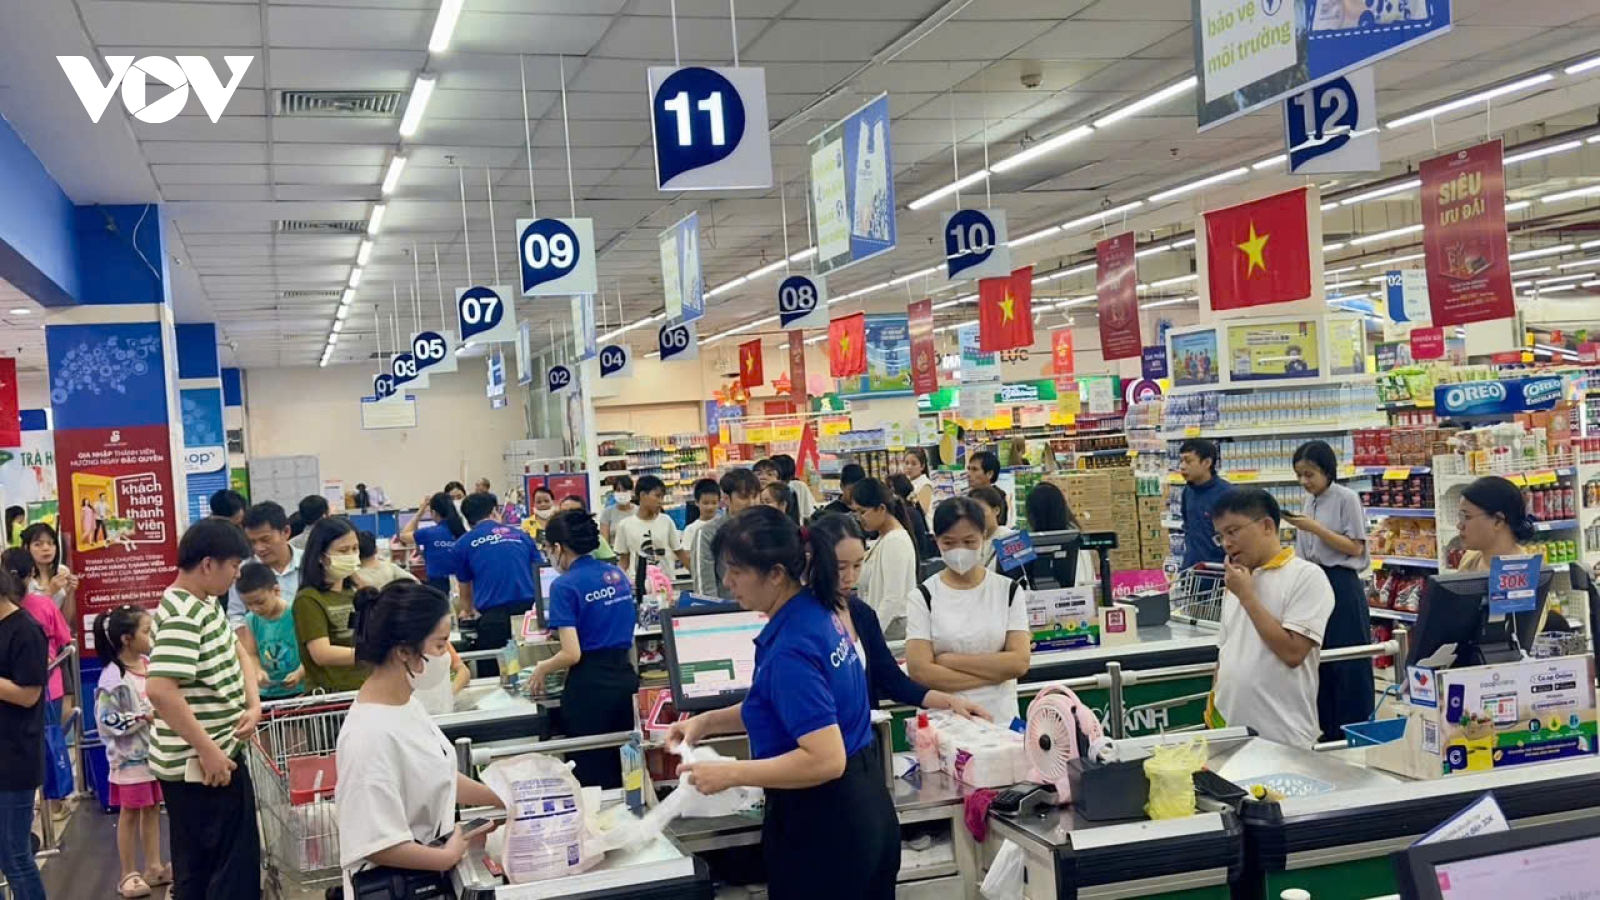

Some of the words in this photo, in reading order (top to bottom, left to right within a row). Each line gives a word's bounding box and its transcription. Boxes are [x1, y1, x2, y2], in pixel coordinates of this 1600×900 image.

[1208, 42, 1235, 75] môi
[1238, 20, 1291, 60] trường
[664, 91, 726, 146] 11
[1294, 87, 1350, 136] 12
[1439, 171, 1482, 205] SIÊU
[950, 222, 989, 255] 10
[524, 232, 575, 269] 09
[781, 285, 815, 310] 08
[461, 297, 499, 325] 07
[415, 339, 444, 360] 05
[660, 329, 687, 348] 06
[394, 360, 416, 377] 03
[601, 353, 623, 367] 04
[377, 379, 394, 394] 01
[549, 371, 568, 385] 02
[1446, 384, 1501, 408] OREO
[121, 482, 162, 495] khách
[130, 493, 163, 506] hàng
[126, 506, 164, 519] thành
